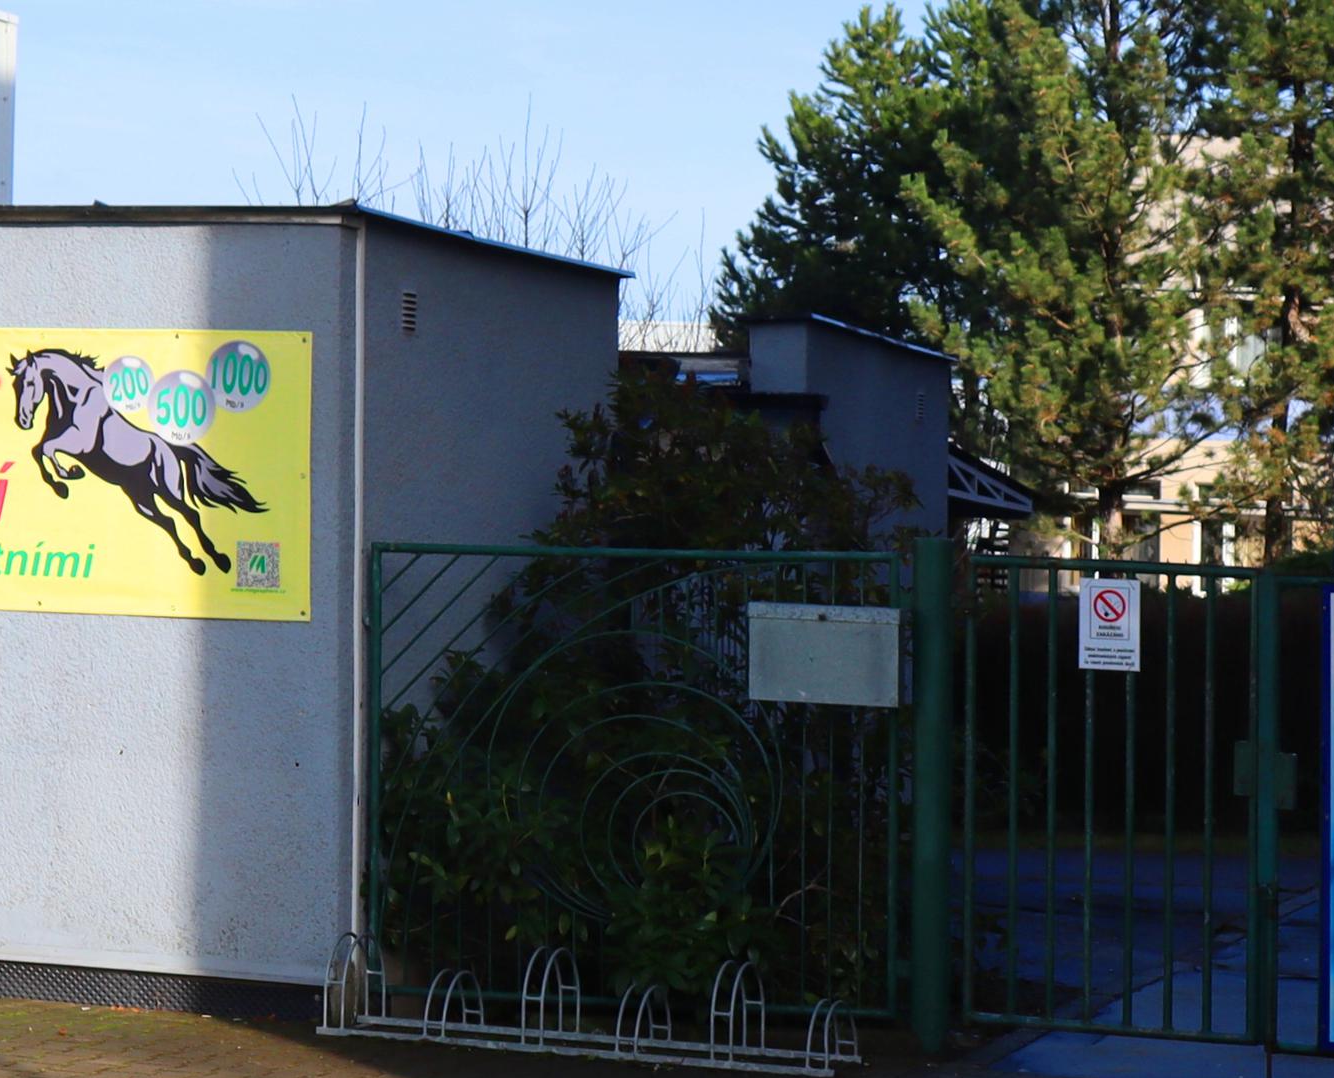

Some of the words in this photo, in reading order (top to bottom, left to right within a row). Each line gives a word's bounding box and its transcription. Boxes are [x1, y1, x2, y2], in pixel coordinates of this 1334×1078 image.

[110, 367, 149, 401] 200
[211, 352, 267, 396] 1000
[156, 384, 207, 428] 500
